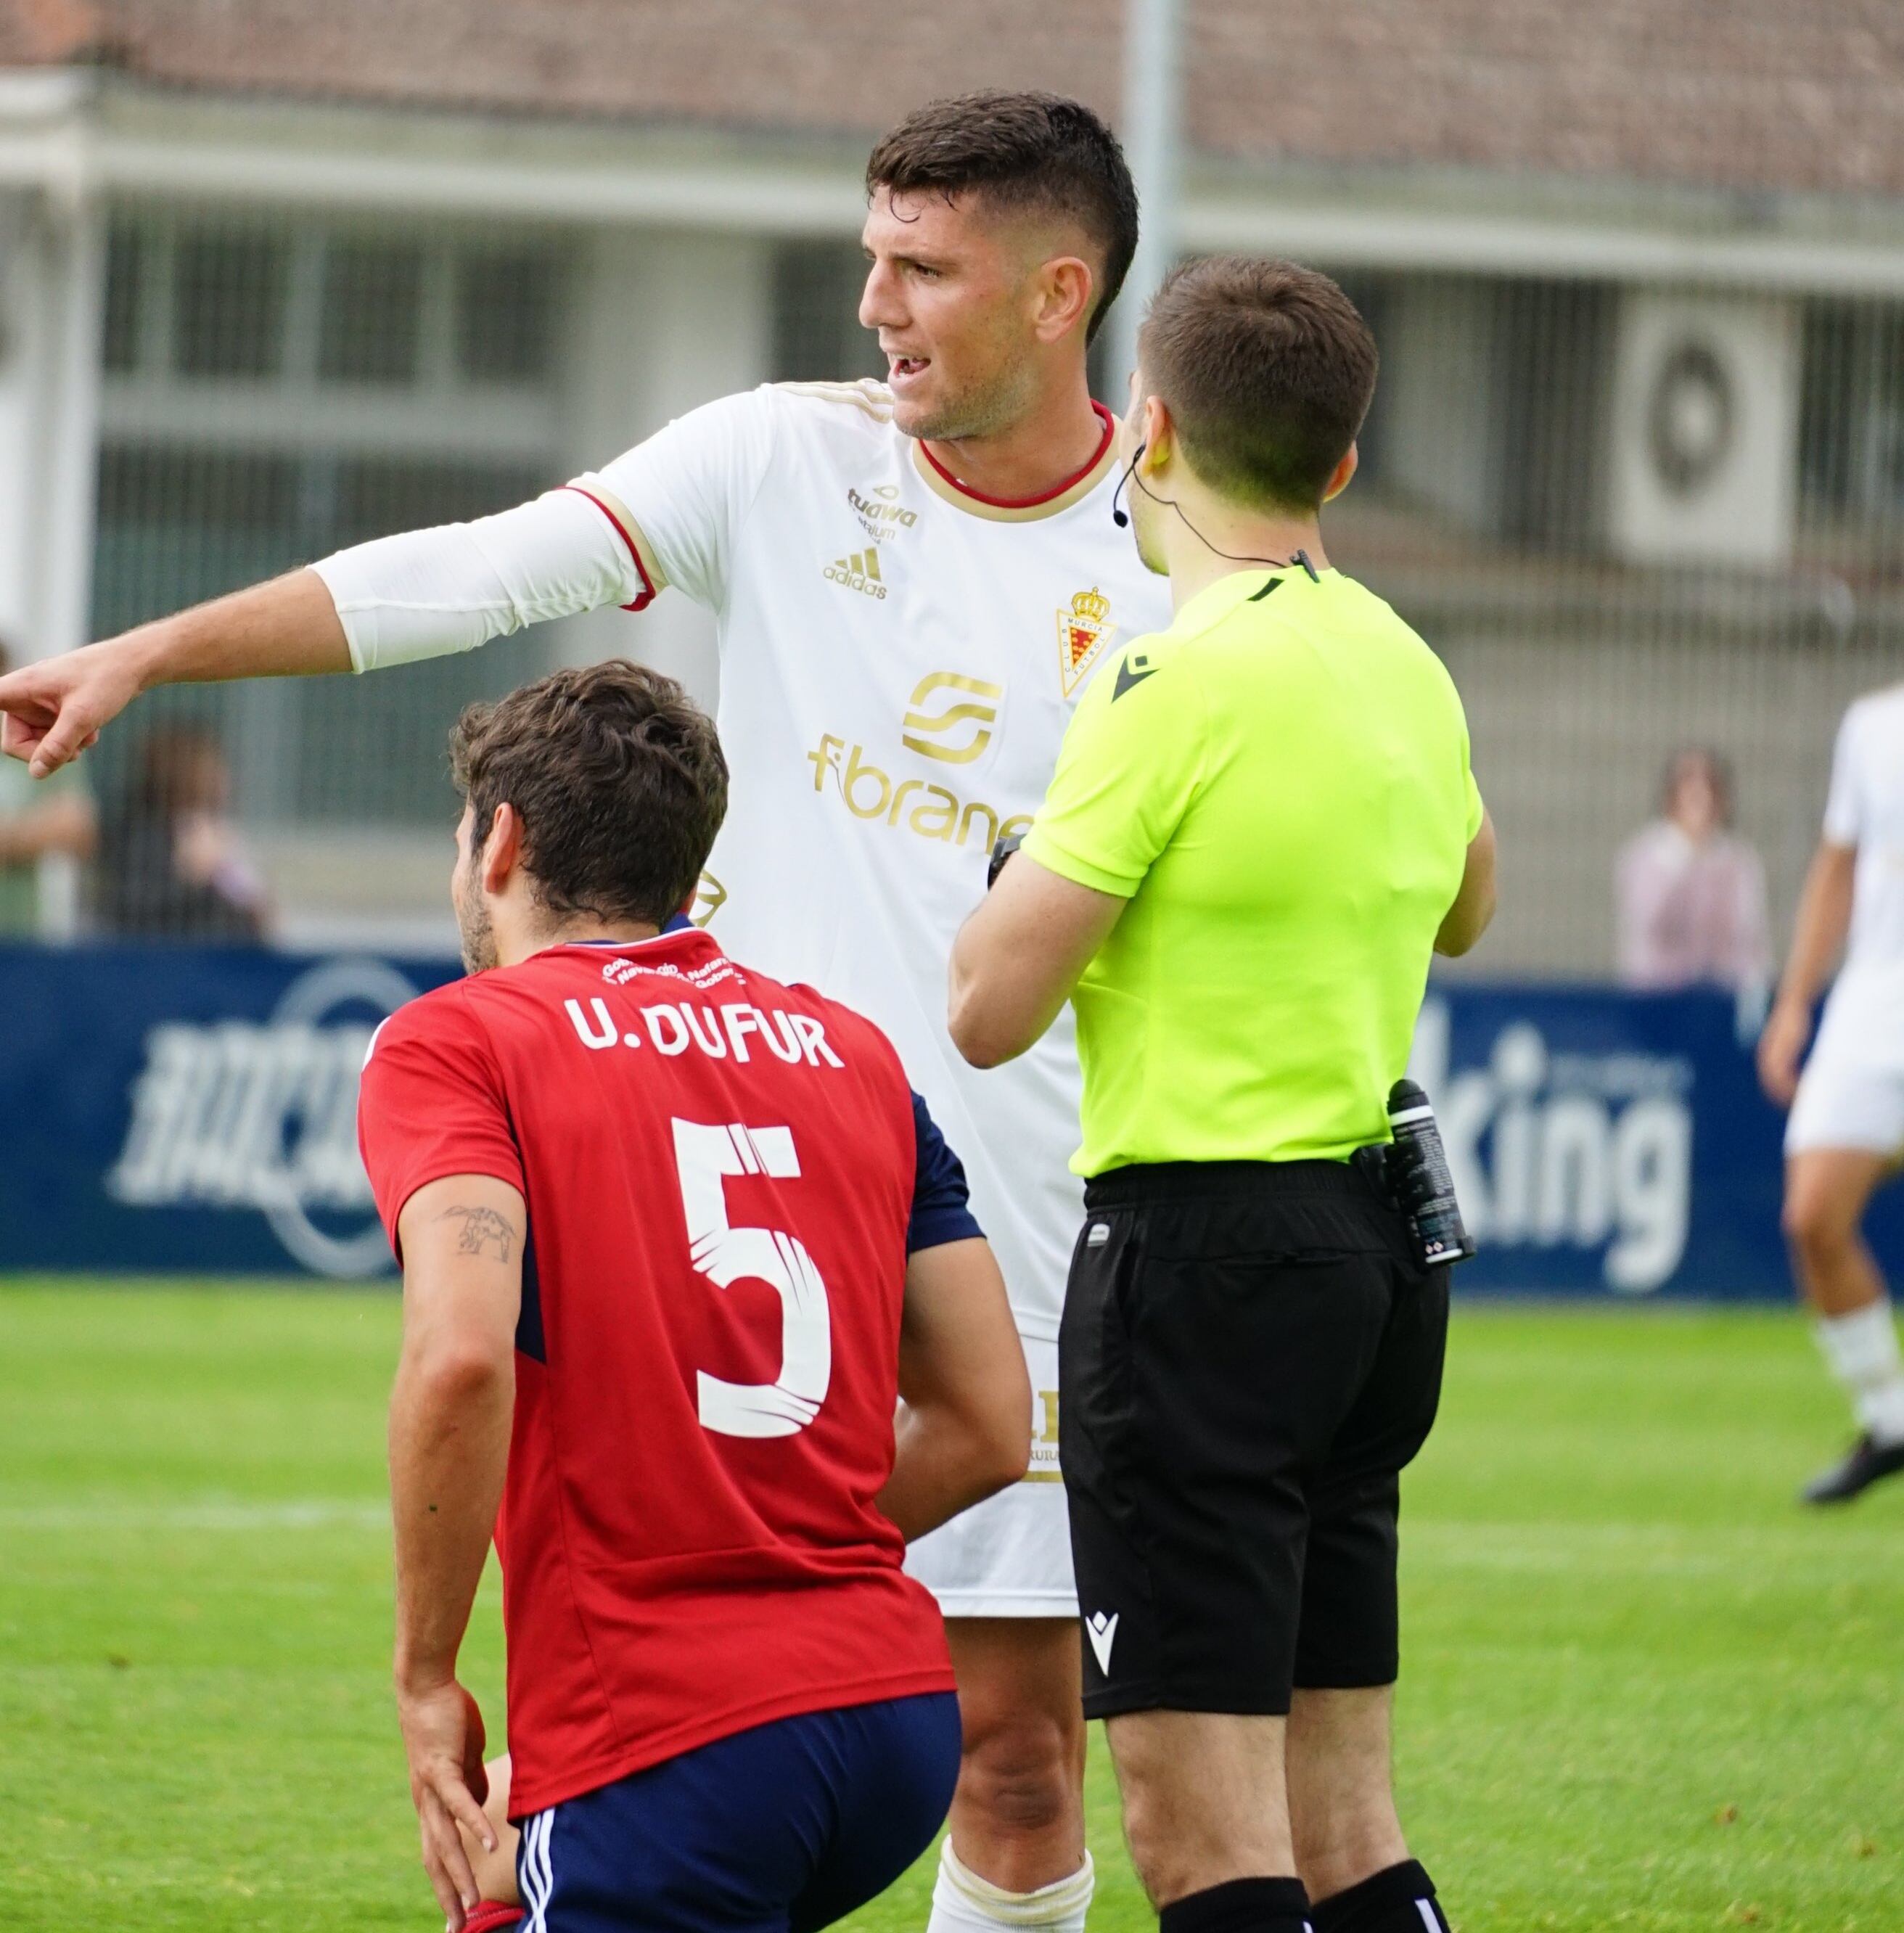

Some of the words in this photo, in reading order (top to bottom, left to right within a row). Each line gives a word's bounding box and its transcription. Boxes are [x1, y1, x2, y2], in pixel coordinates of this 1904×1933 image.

[823, 563, 886, 600] adidas
[1068, 617, 1103, 633] MURCIA
[1062, 628, 1071, 673] CLUB
[1074, 637, 1106, 676] FUTBOL
[671, 1116, 832, 1439] 5
